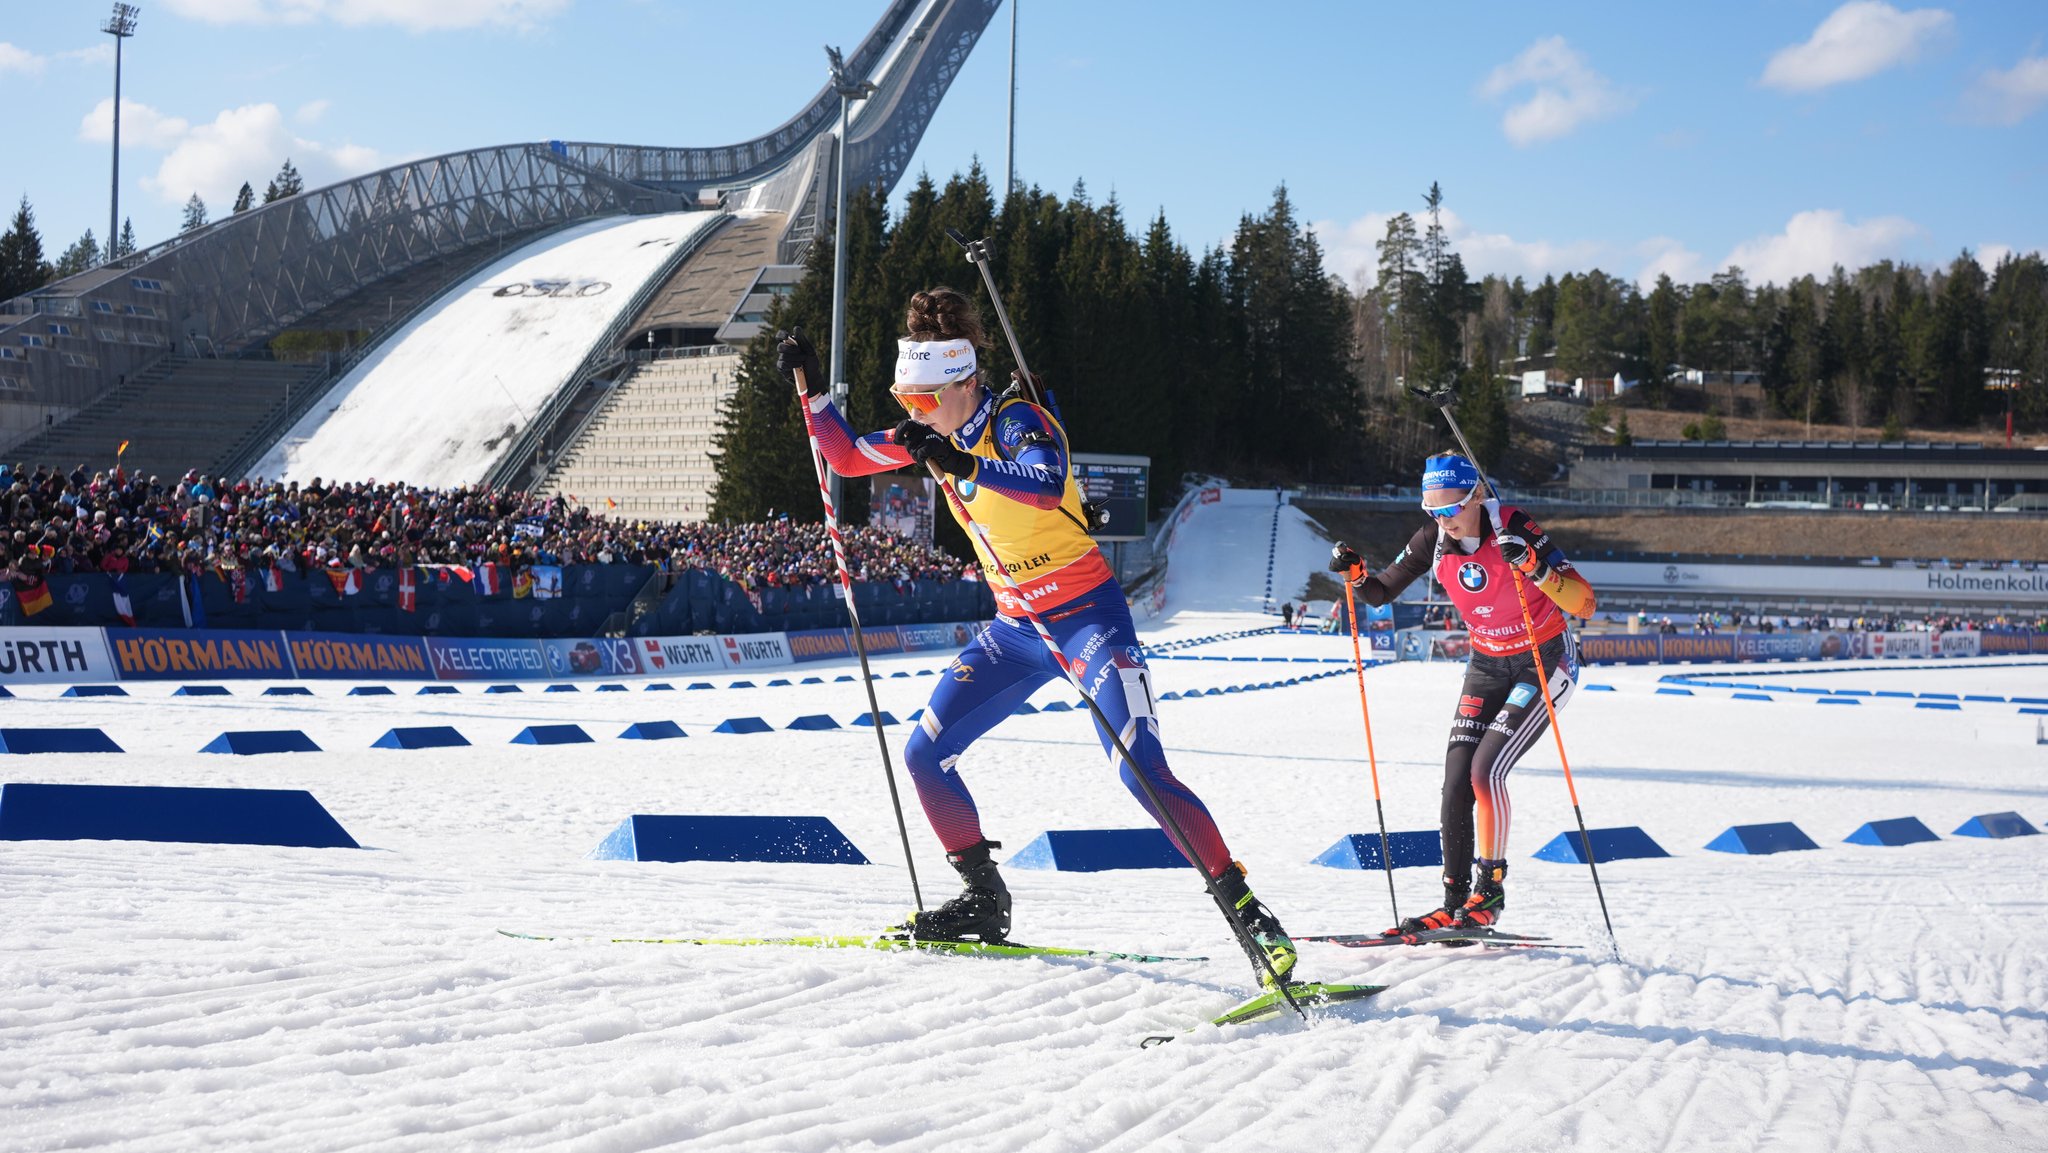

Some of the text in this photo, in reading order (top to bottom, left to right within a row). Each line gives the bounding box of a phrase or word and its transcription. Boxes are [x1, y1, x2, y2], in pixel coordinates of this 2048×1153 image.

[116, 636, 282, 672] HÖRMANN
[790, 634, 848, 656] HÖRMANN
[849, 632, 900, 652] HRMANN
[1080, 632, 1102, 659] CAISSE
[1375, 636, 1390, 647] X3
[1583, 638, 1656, 658] HÖRMANN
[1664, 637, 1731, 657] HÖRMANN
[1846, 634, 1864, 657] X3
[291, 640, 426, 671] HÖRMANN
[603, 640, 637, 674] X3
[951, 657, 974, 682] mfy
[1089, 658, 1118, 700] RAFT
[1139, 672, 1153, 715] 1
[1553, 679, 1569, 709] 2
